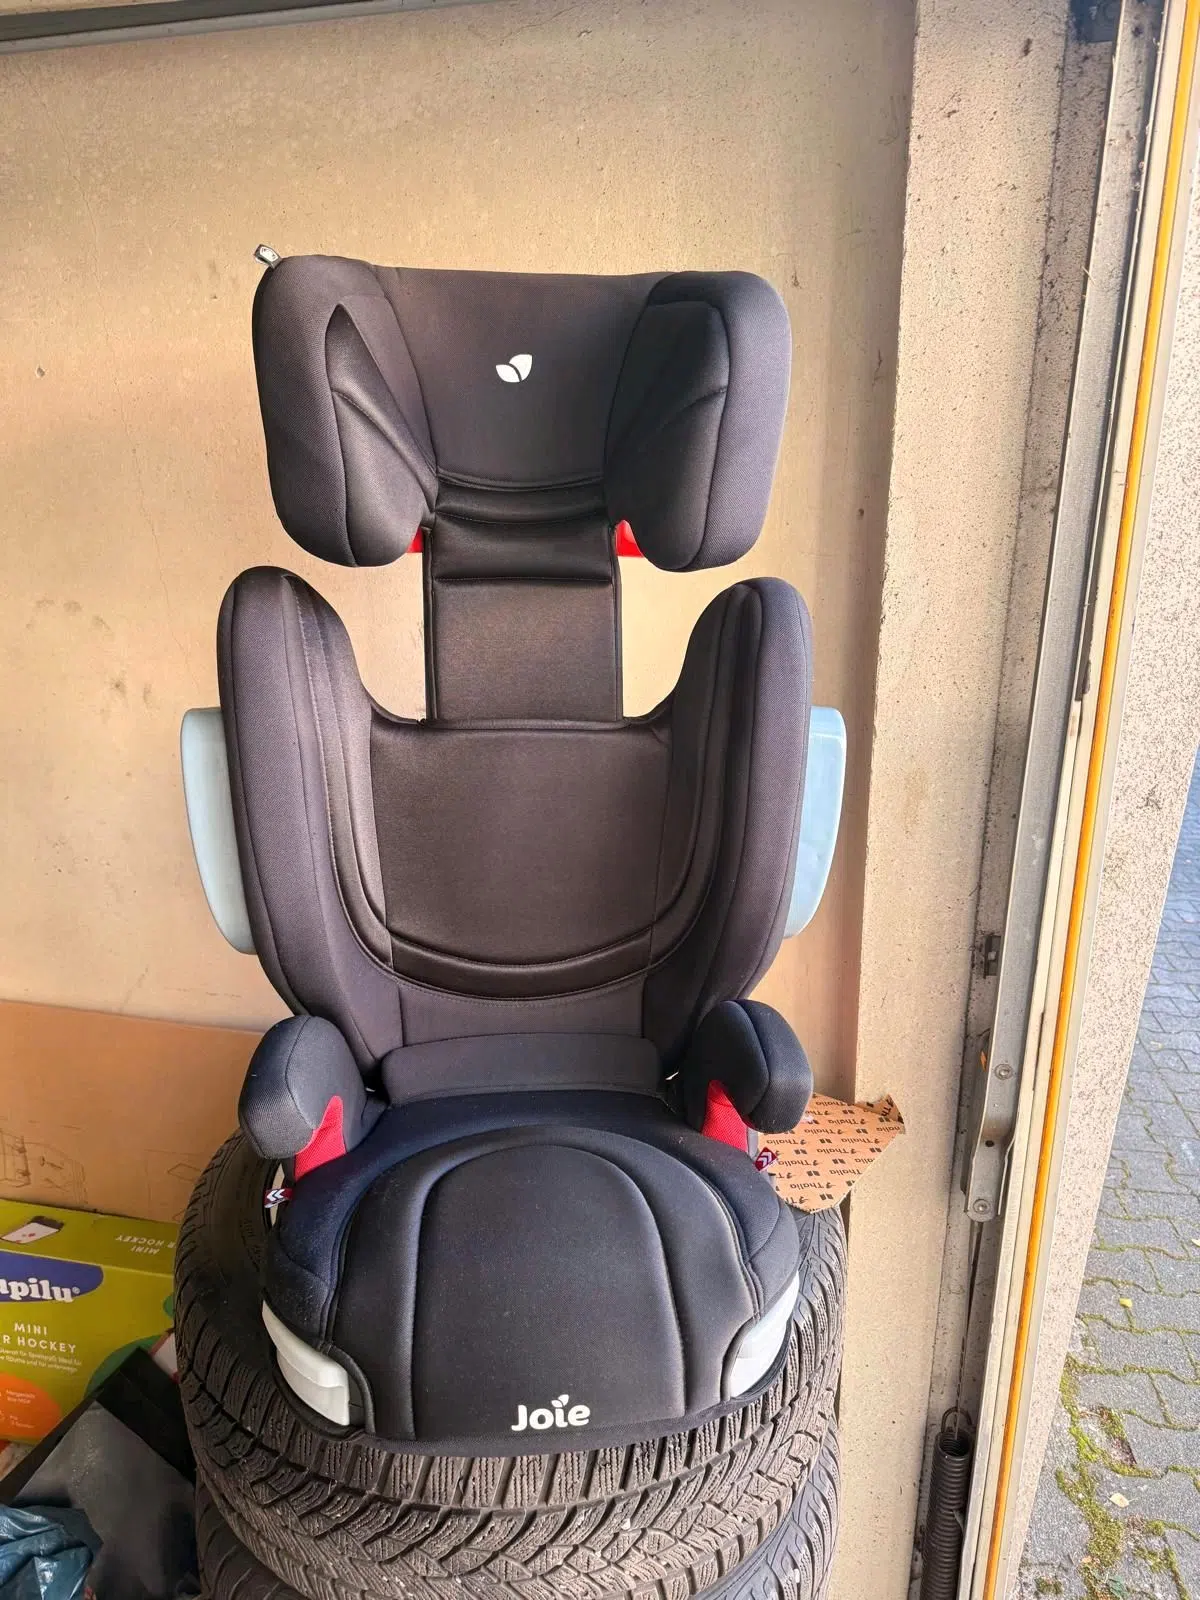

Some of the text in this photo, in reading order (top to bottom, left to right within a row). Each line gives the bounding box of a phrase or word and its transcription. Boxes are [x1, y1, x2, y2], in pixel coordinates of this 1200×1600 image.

[829, 1168, 864, 1176] Thalia
[789, 1182, 826, 1190] Thalia
[115, 1235, 165, 1247] HOCKEY
[14, 1322, 47, 1336] MINI
[17, 1336, 76, 1353] HOCKEY
[511, 1394, 591, 1431] Joie
